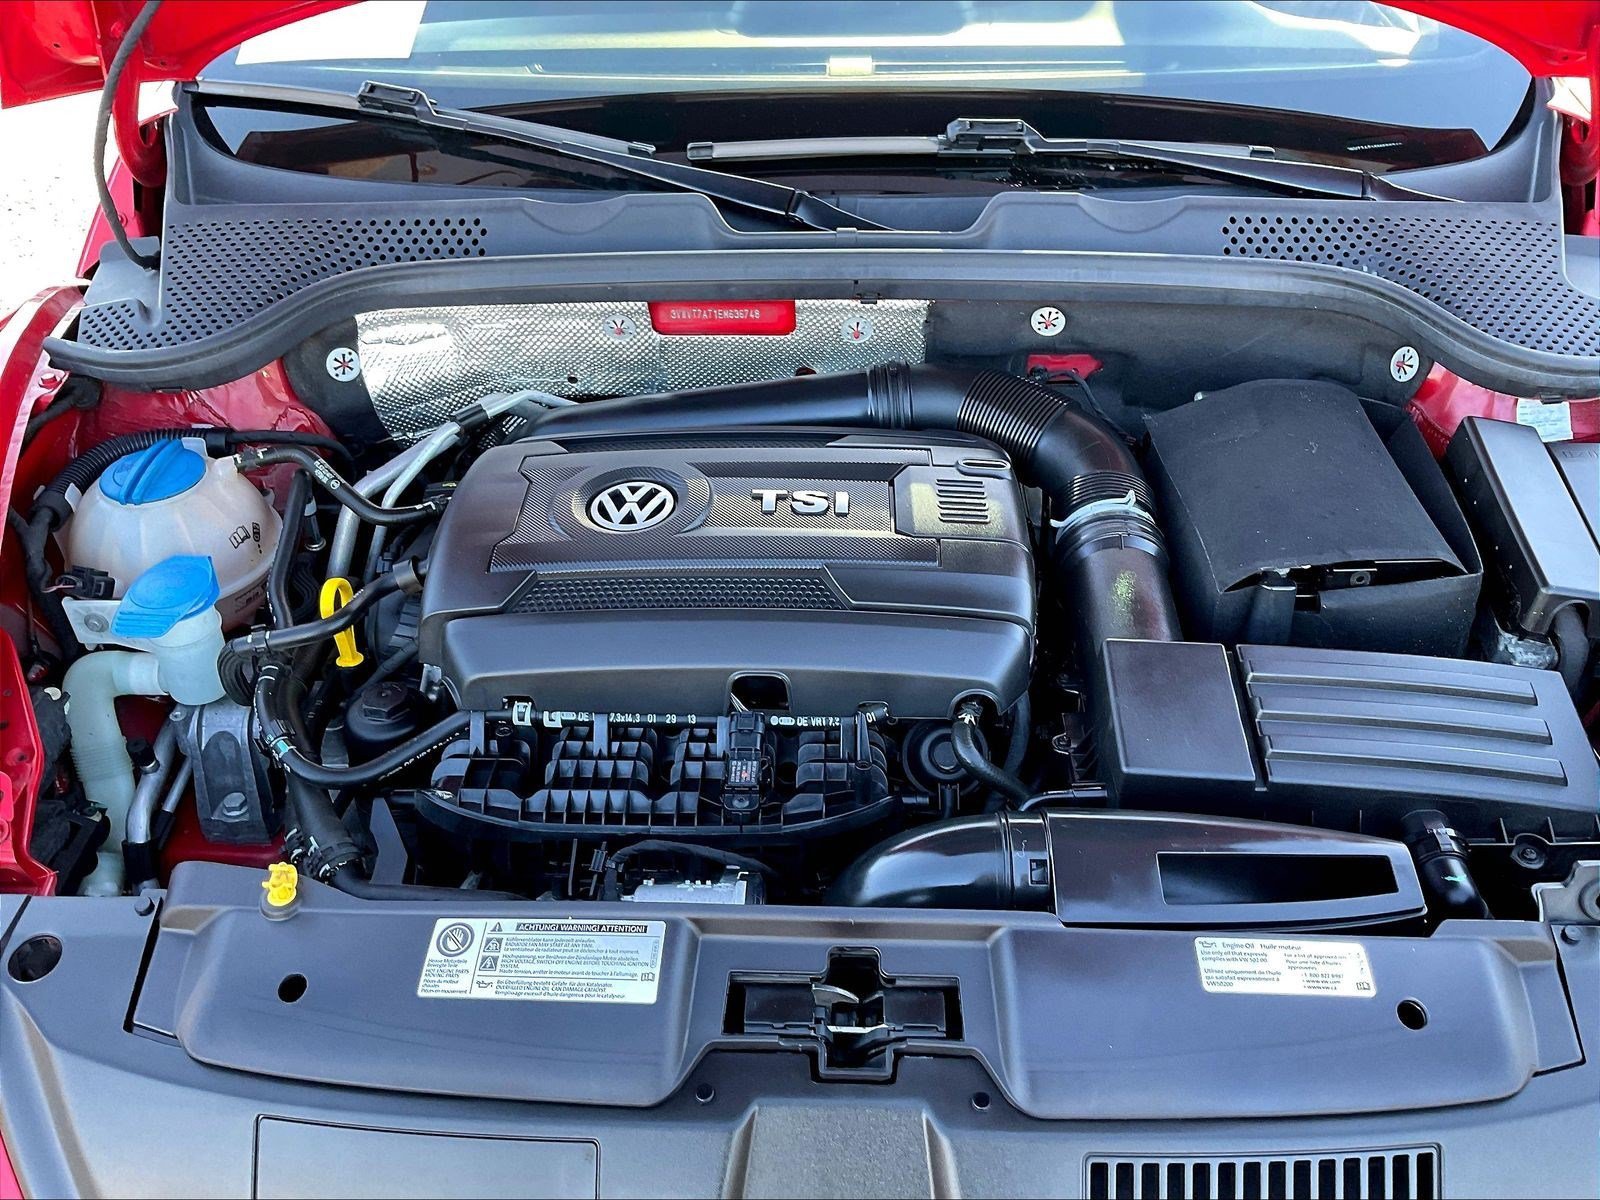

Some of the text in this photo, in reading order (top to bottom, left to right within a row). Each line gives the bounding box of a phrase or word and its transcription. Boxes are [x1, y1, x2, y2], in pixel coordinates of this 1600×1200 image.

[589, 480, 676, 532] VW
[751, 487, 850, 517] TSI
[647, 713, 657, 723] 01
[665, 714, 677, 724] 29
[687, 714, 697, 724] 13
[796, 716, 809, 727] DE
[518, 924, 645, 933] ACHTUNG! WARNING! ATTENTION!
[1222, 942, 1244, 950] Engine
